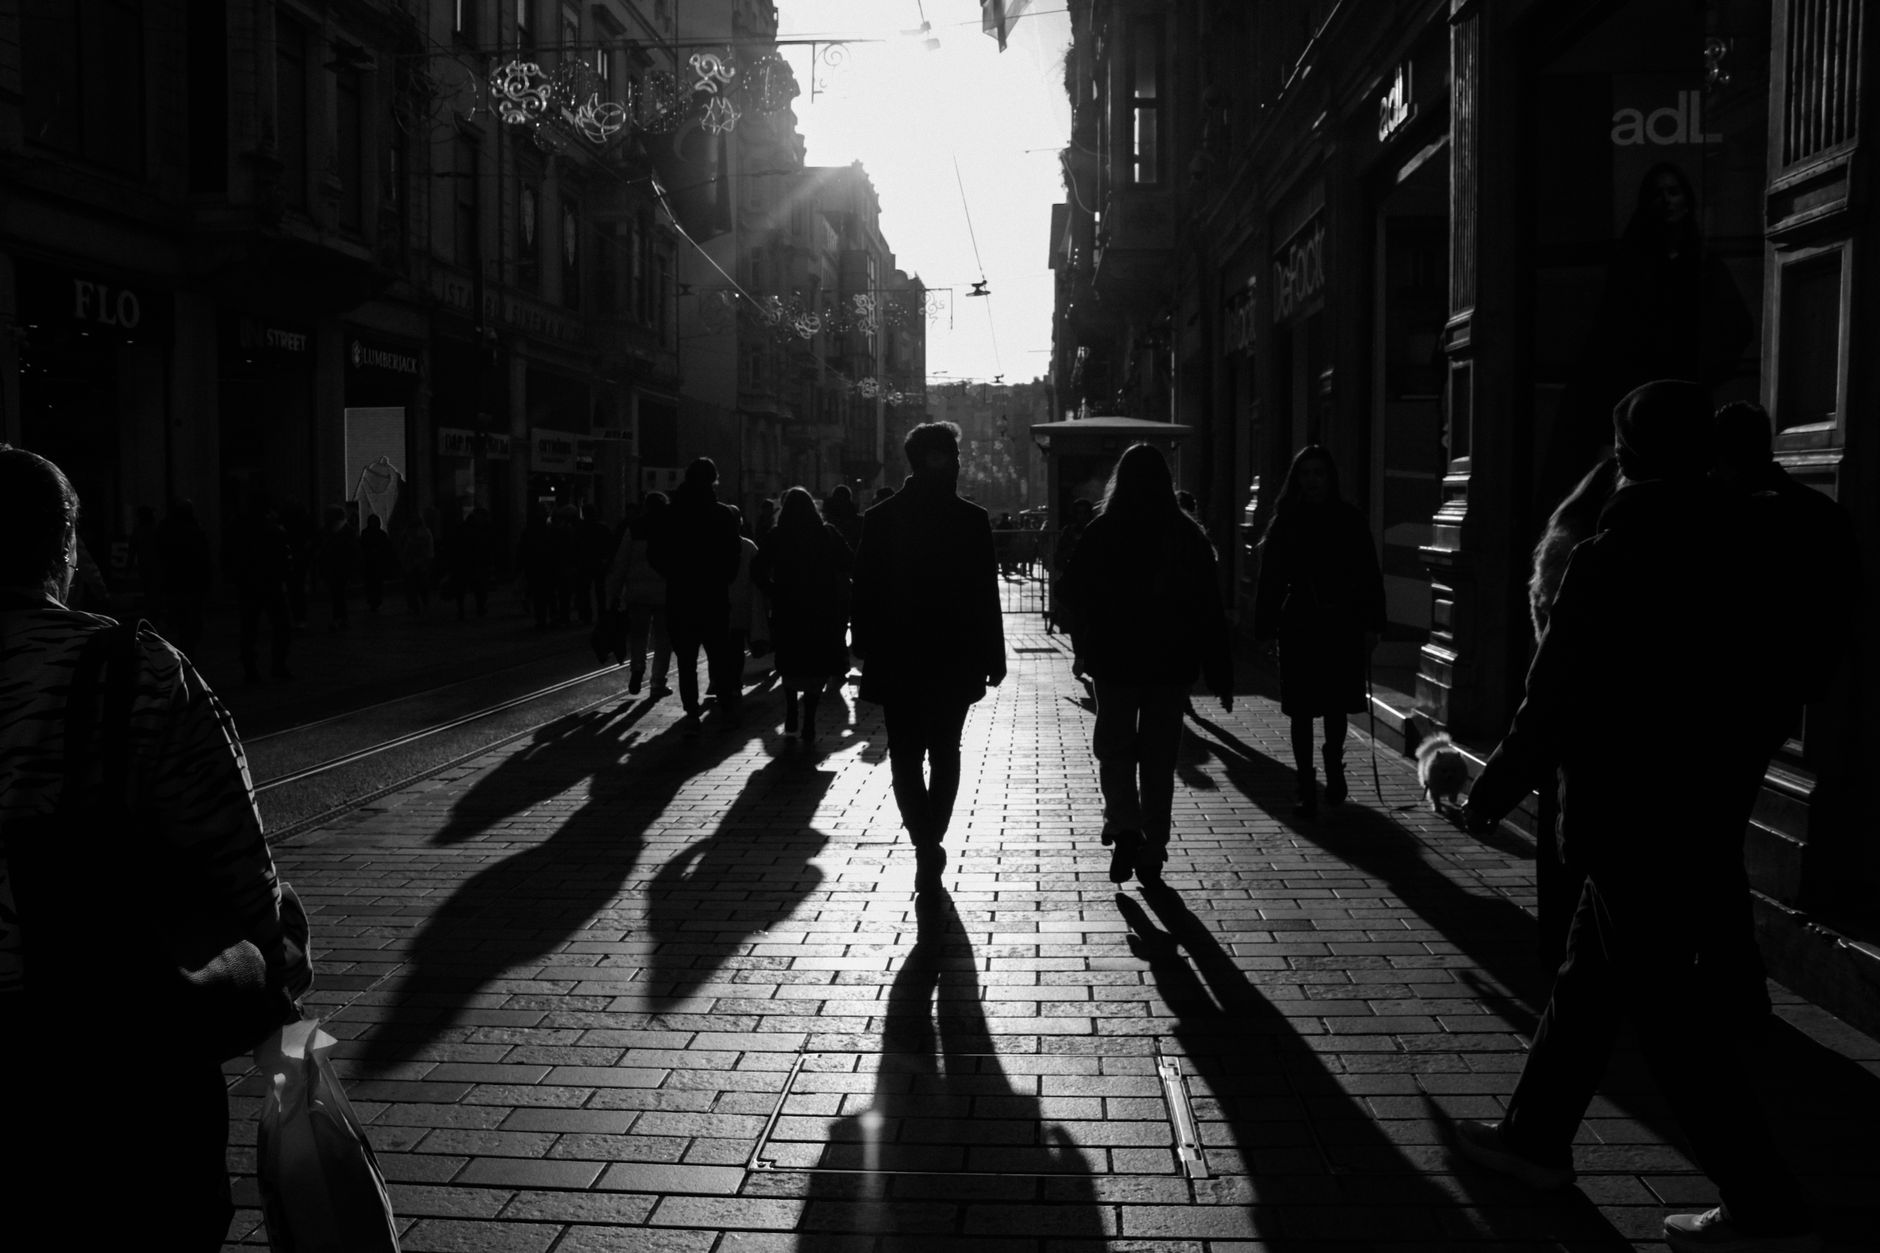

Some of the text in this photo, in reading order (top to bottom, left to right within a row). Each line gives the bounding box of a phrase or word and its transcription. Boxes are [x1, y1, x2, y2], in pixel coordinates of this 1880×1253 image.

[73, 278, 141, 329] FLO
[267, 328, 307, 352] STREET
[363, 347, 418, 375] LUMBERJACK
